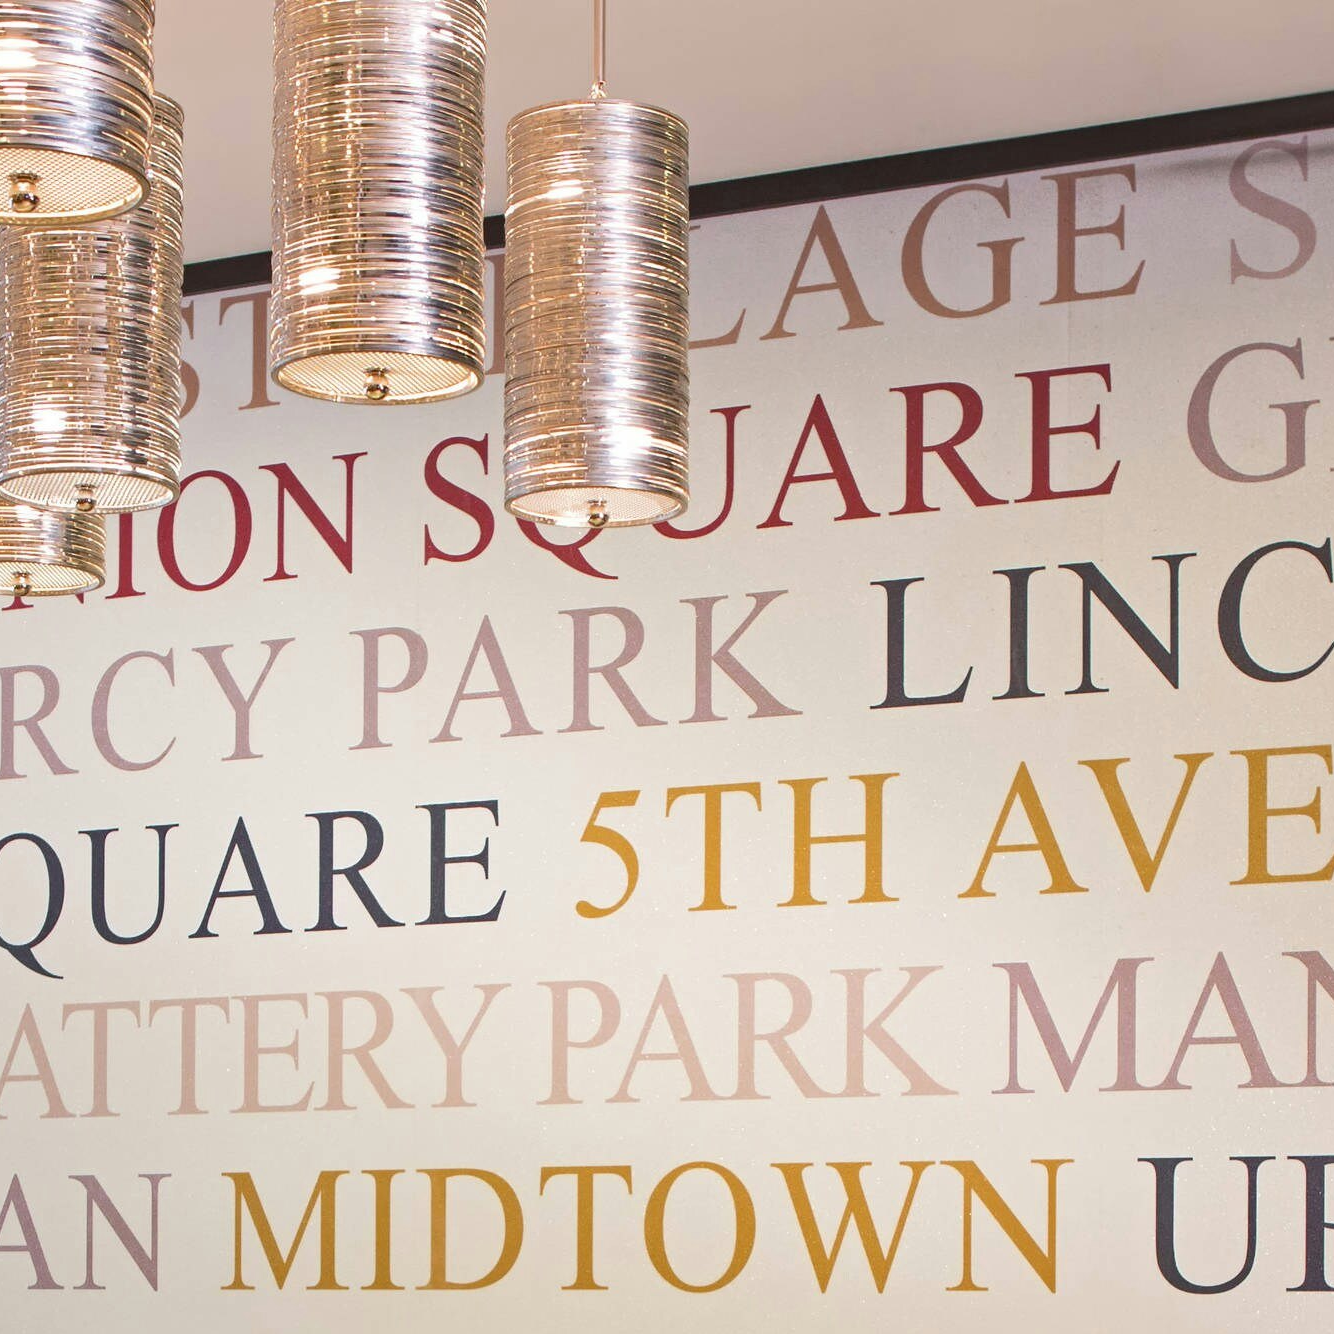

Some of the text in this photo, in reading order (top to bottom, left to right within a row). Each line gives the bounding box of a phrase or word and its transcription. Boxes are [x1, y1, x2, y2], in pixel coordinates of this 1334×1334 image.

[349, 590, 803, 750] PARK
[575, 772, 900, 919] 5TH
[537, 967, 957, 1105] PARK
[220, 1159, 1075, 1294] MIDTOWN
